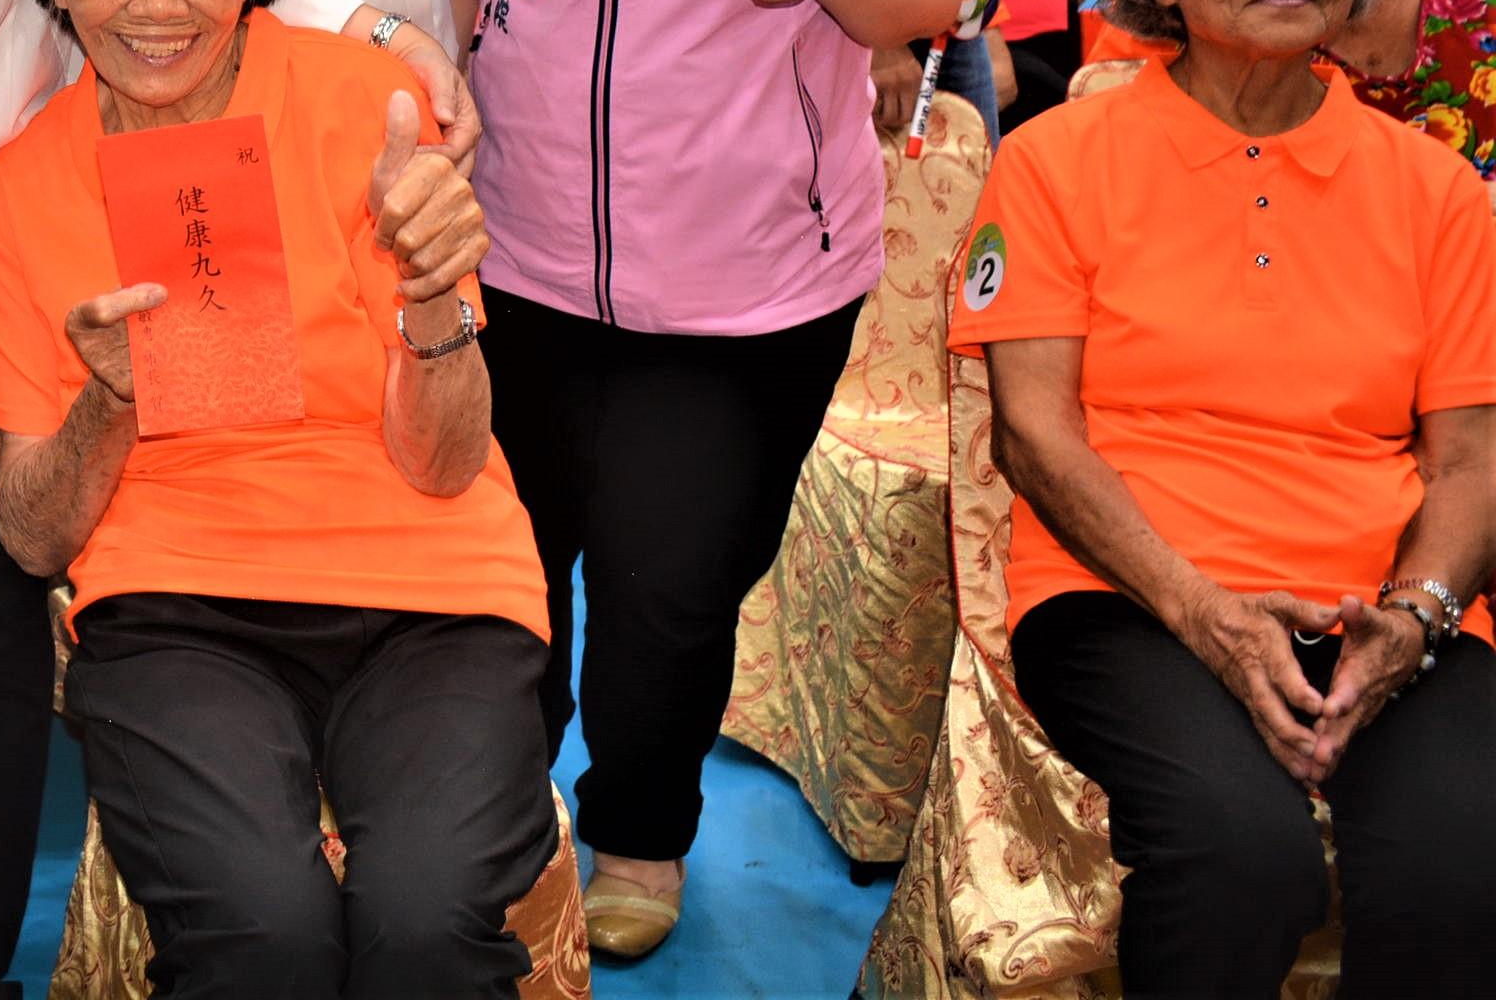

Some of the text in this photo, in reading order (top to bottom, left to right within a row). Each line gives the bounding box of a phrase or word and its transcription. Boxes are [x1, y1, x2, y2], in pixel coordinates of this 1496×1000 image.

[236, 147, 259, 165] 祝
[175, 186, 227, 313] 健康九久
[978, 257, 996, 297] 2
